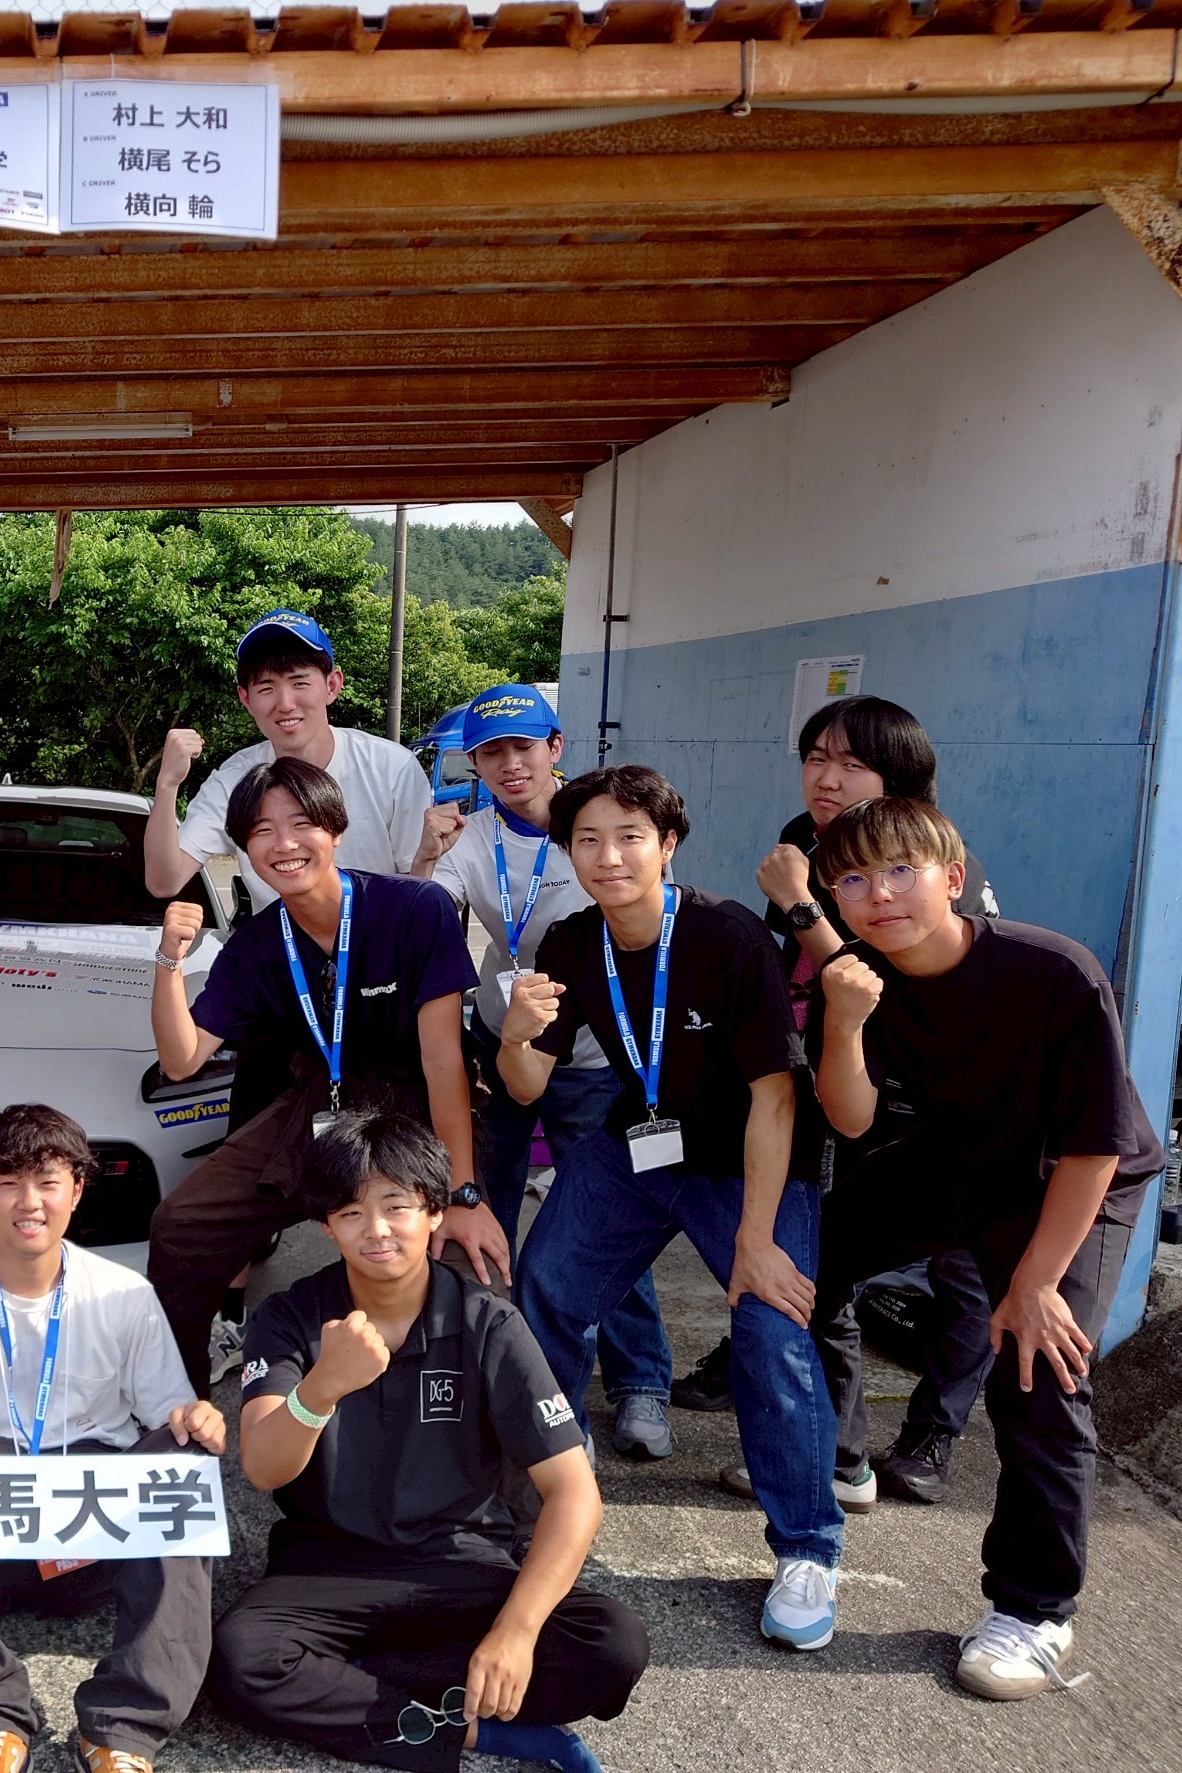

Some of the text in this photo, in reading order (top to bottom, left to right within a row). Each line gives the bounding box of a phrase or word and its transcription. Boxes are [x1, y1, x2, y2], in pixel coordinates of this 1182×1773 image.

[112, 102, 228, 130] 村上 大和
[118, 147, 221, 174] 横尾 そら
[124, 192, 214, 219] 横向 輪
[473, 696, 535, 713] GOODYEAR
[551, 880, 570, 888] TODAY
[341, 895, 351, 949] FORMULA GYMKHANA
[659, 915, 673, 972] FORMULA GYMKHANA
[73, 962, 149, 974] BRIDGESTONE
[91, 976, 151, 987] YOKOHAMA
[619, 1012, 640, 1068] FORMULA GYMKHANA
[652, 1010, 663, 1066] FORMULA GYMKHANA
[159, 1102, 231, 1124] GOODYEAR
[902, 1319, 915, 1329] Ltd.
[44, 1358, 53, 1384] FORMULA
